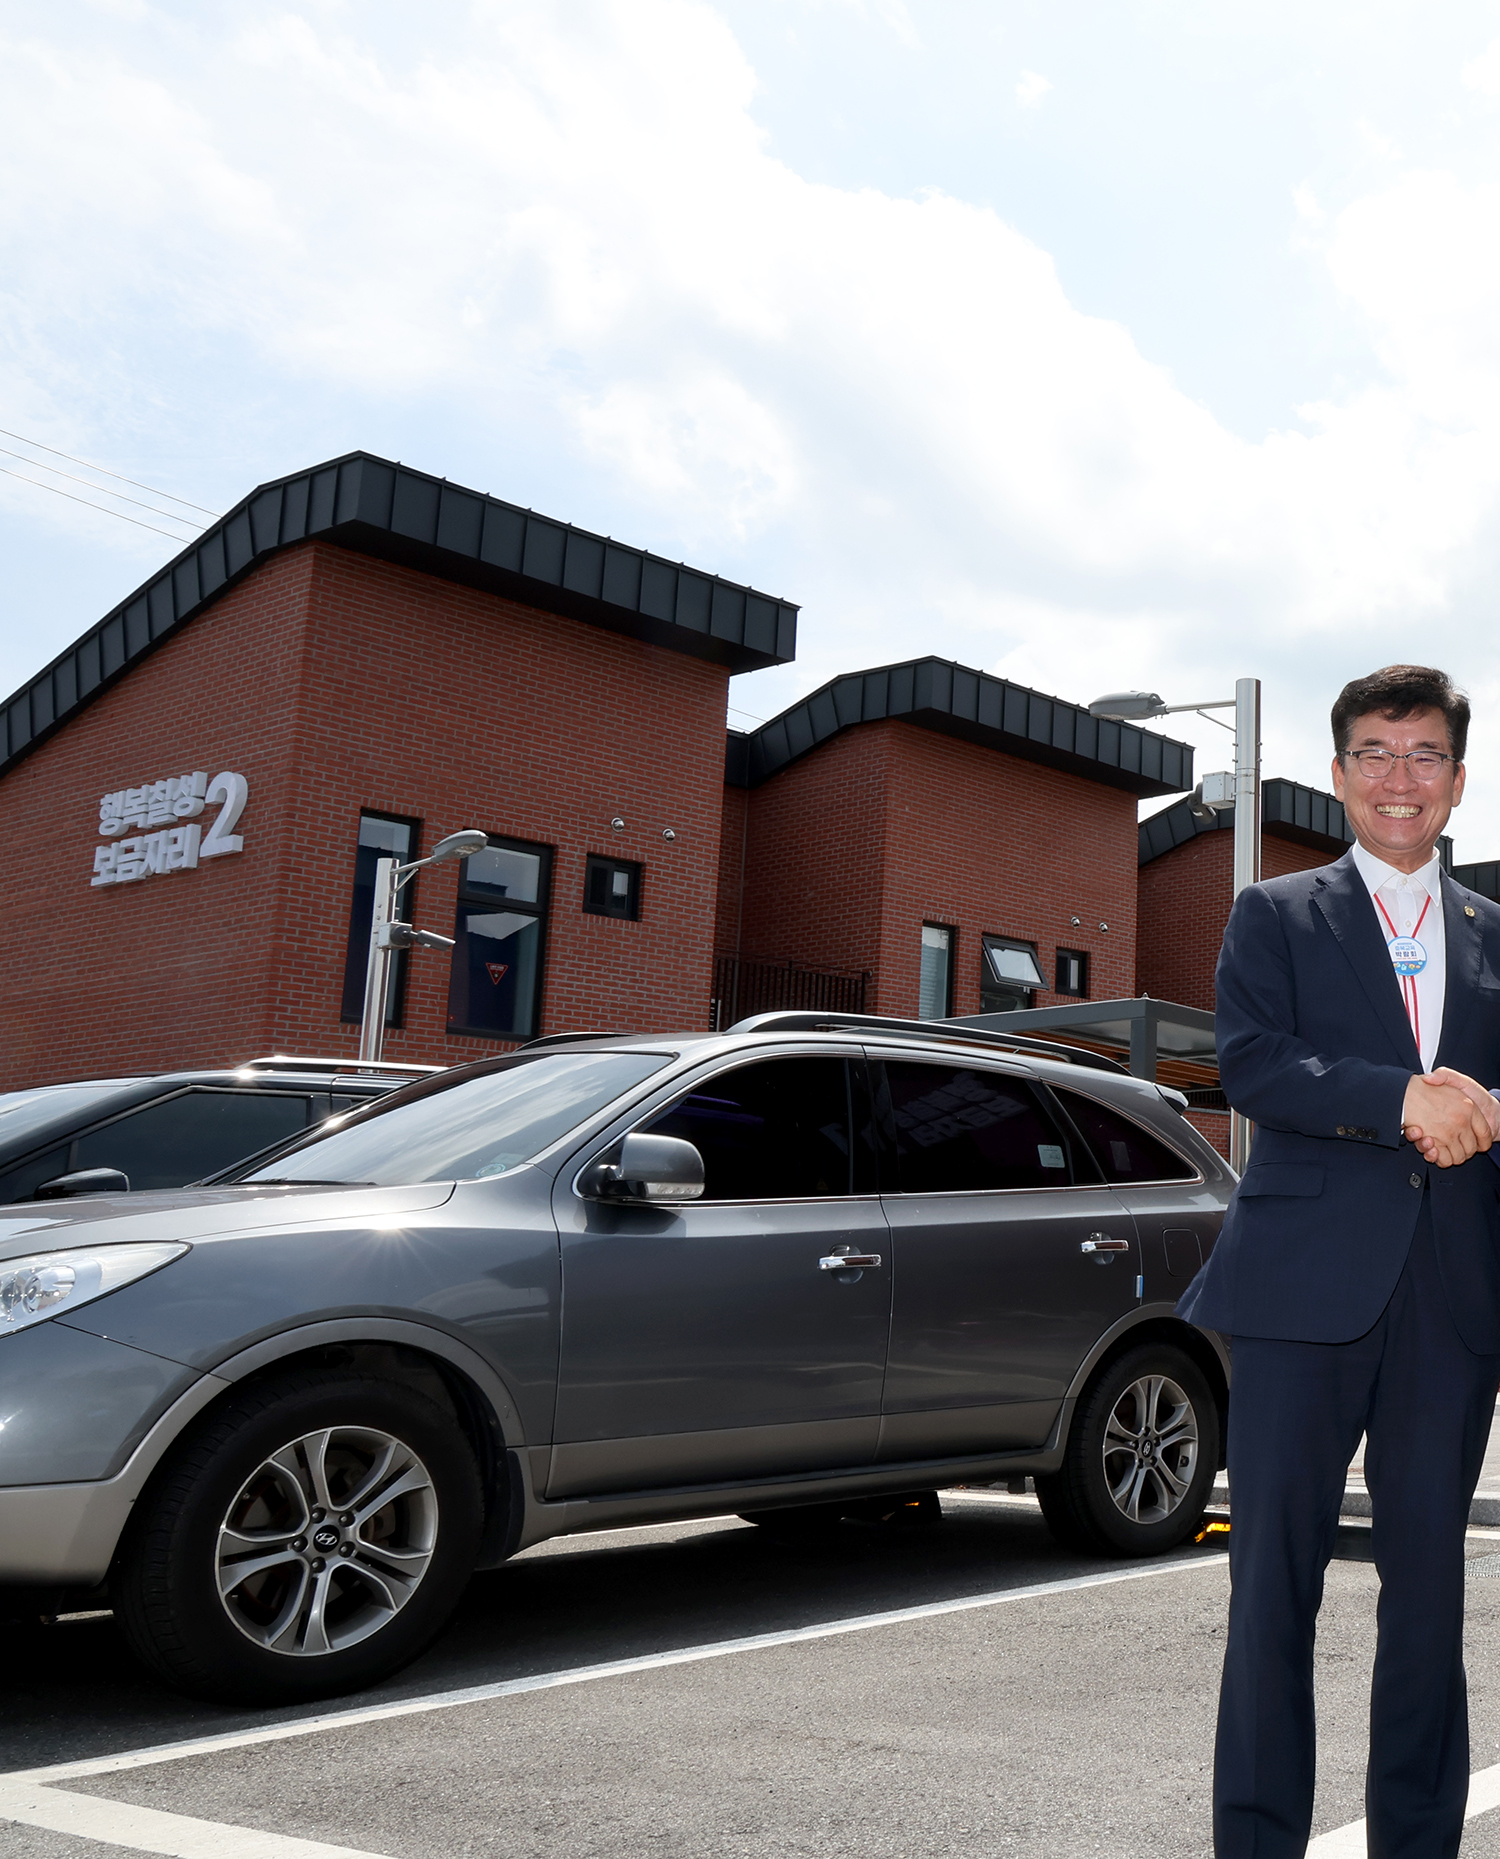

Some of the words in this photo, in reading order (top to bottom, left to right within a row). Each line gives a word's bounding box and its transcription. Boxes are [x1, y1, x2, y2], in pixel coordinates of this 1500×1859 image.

[98, 771, 208, 836] 행복칠성
[199, 771, 248, 858] 2
[90, 823, 202, 886] 보금자리
